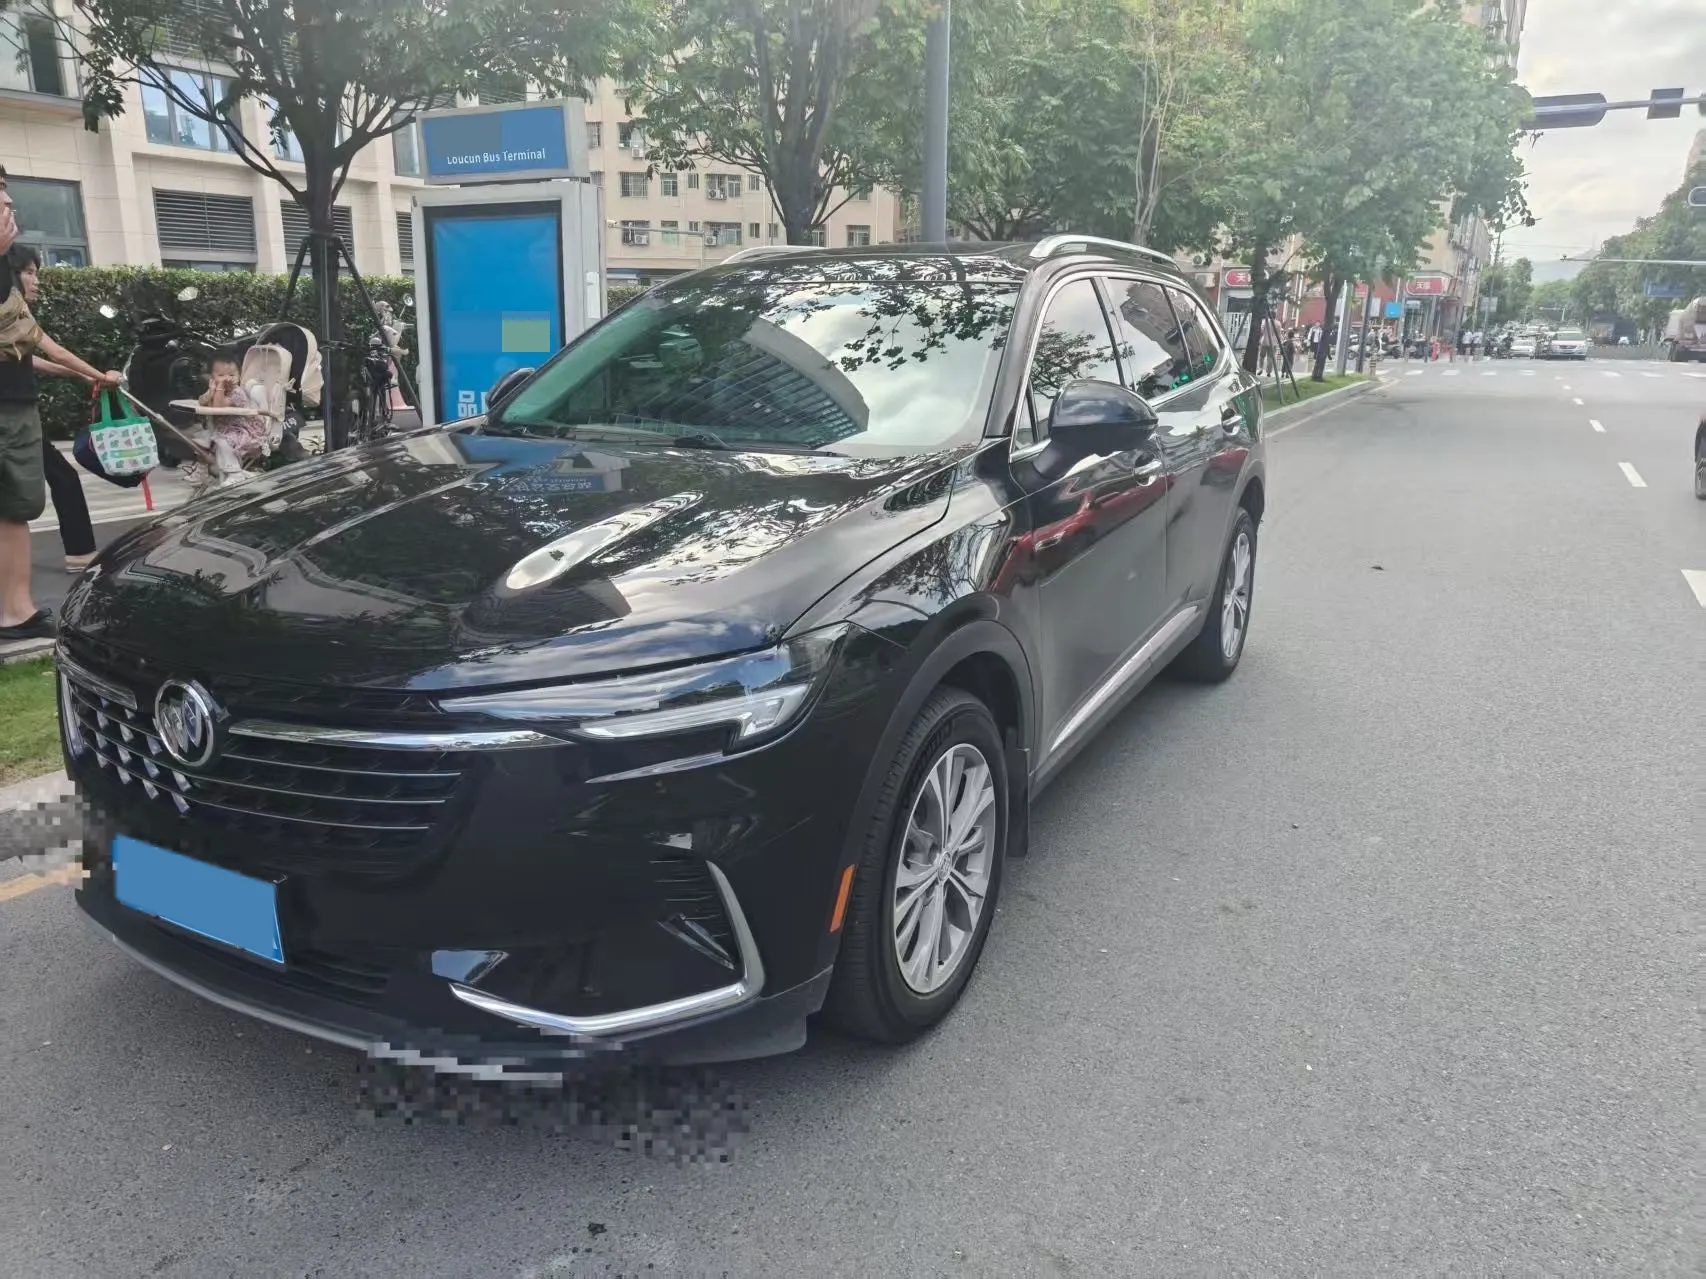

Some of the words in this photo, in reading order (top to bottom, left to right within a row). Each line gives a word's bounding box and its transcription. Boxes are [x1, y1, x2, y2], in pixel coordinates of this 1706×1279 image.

[447, 155, 481, 165] Loucun
[483, 152, 500, 163] Bus
[503, 148, 546, 162] Terminal
